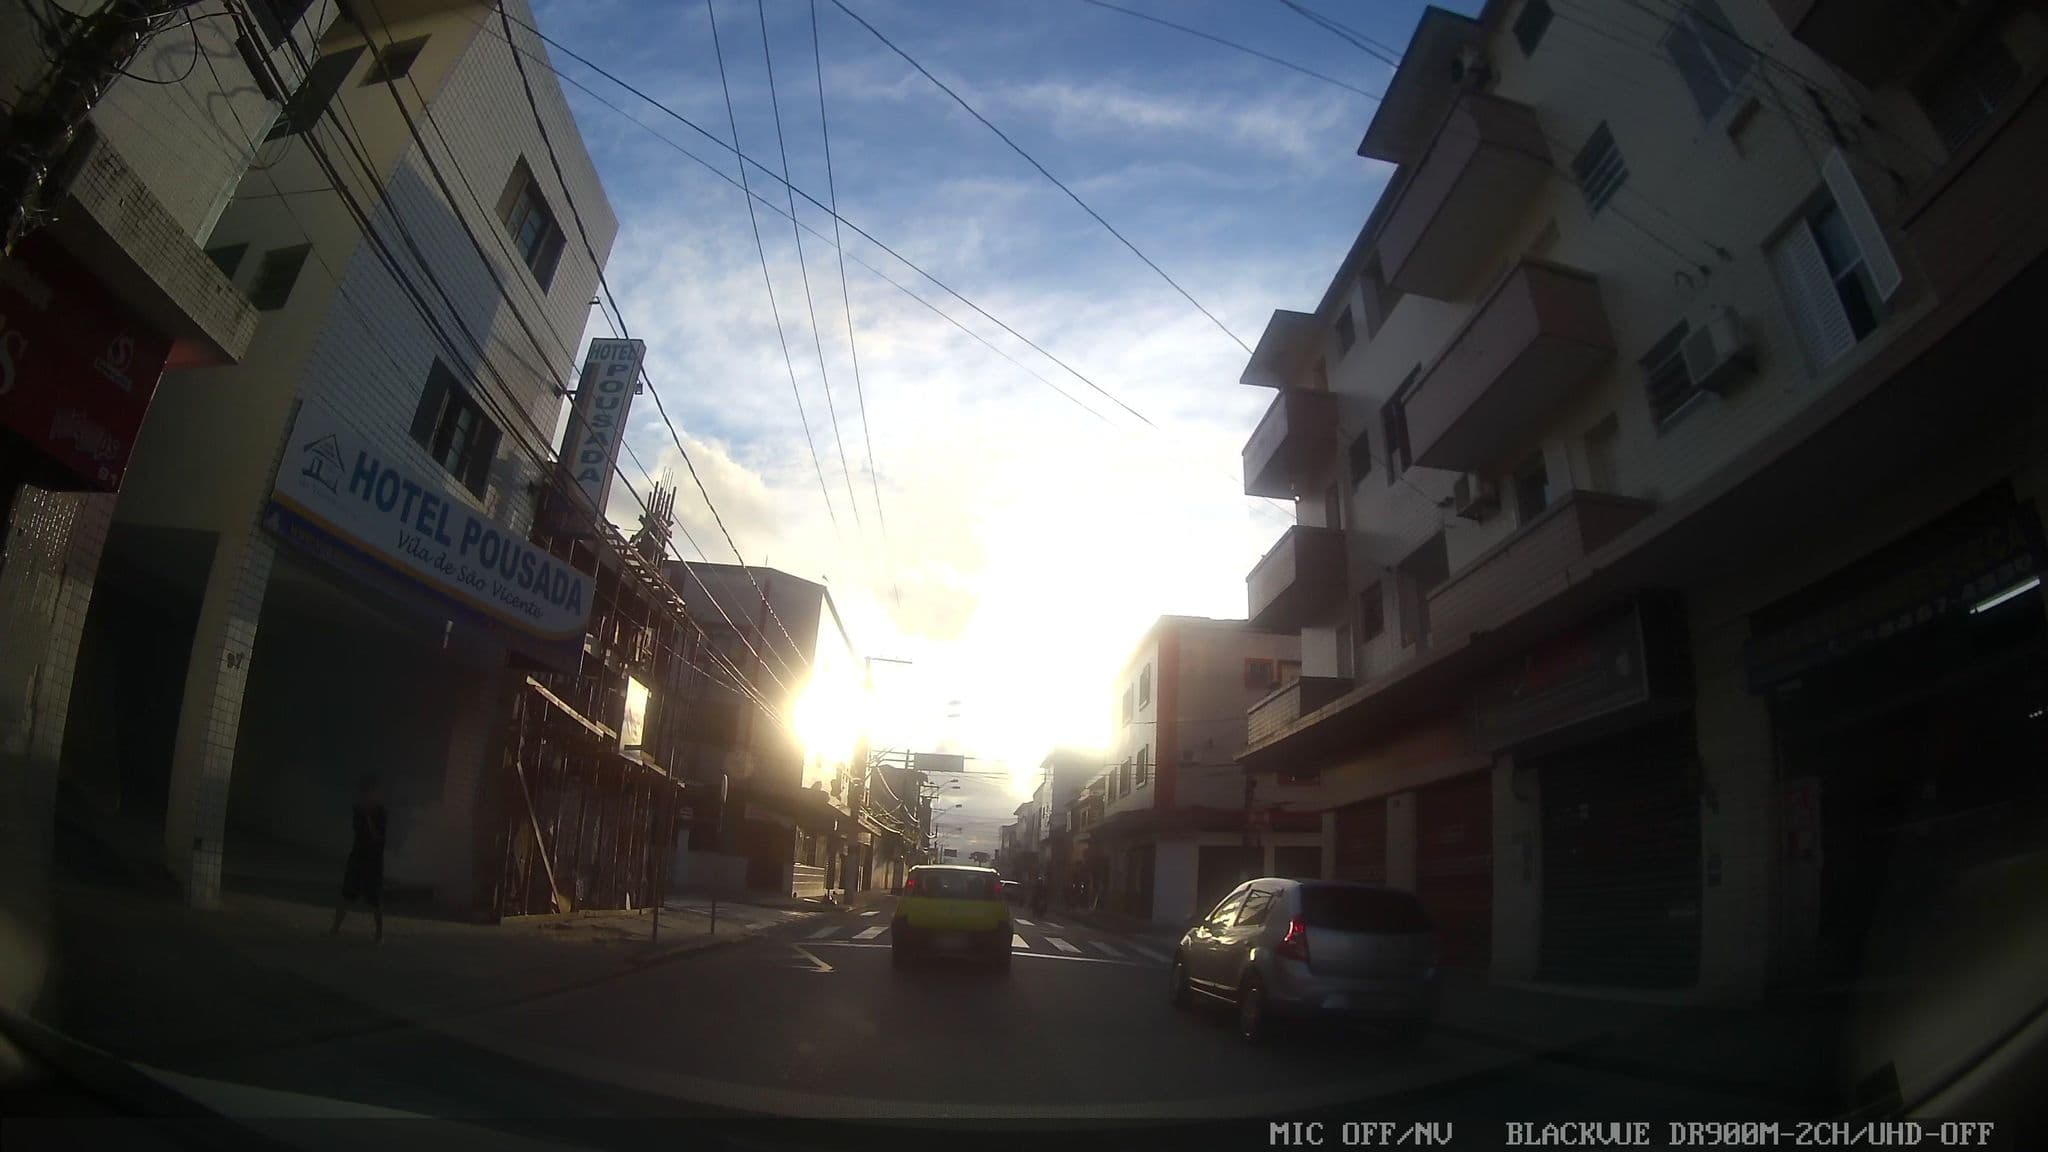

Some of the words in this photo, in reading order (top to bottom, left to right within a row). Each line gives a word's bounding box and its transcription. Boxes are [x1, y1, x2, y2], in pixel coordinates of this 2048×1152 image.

[590, 344, 637, 360] HOTEL
[577, 364, 629, 482] POUSADA
[350, 451, 452, 547] HOTEL
[460, 516, 582, 616] POUSADA
[398, 529, 432, 561] Vila
[433, 553, 455, 574] de
[456, 566, 486, 590] São
